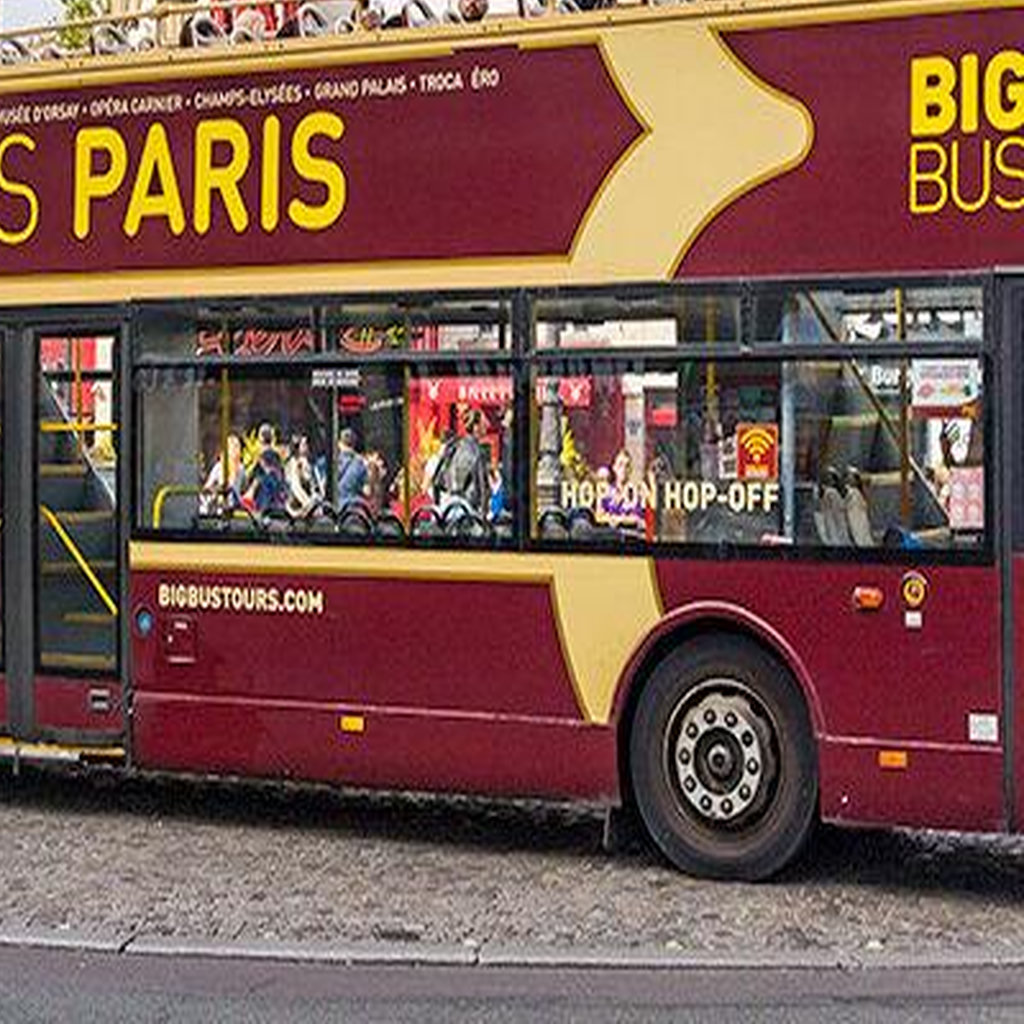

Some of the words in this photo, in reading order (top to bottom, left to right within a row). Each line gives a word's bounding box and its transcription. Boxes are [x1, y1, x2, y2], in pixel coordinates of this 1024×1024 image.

[32, 101, 80, 124] D'ORSAY
[89, 93, 129, 117] OPÉRA
[130, 91, 183, 114] GARNIER
[193, 81, 302, 109] CHAMPS-ELYSÉES
[314, 79, 358, 101] GRAND
[360, 75, 407, 98] PALAIS
[419, 67, 500, 92] TROCAÉRO
[909, 50, 1024, 137] BIG
[73, 111, 347, 240] PARIS
[909, 136, 1024, 214] BUS
[664, 481, 781, 512] HOP-OFF
[157, 582, 324, 615] BIGBUSTOURS.COM
